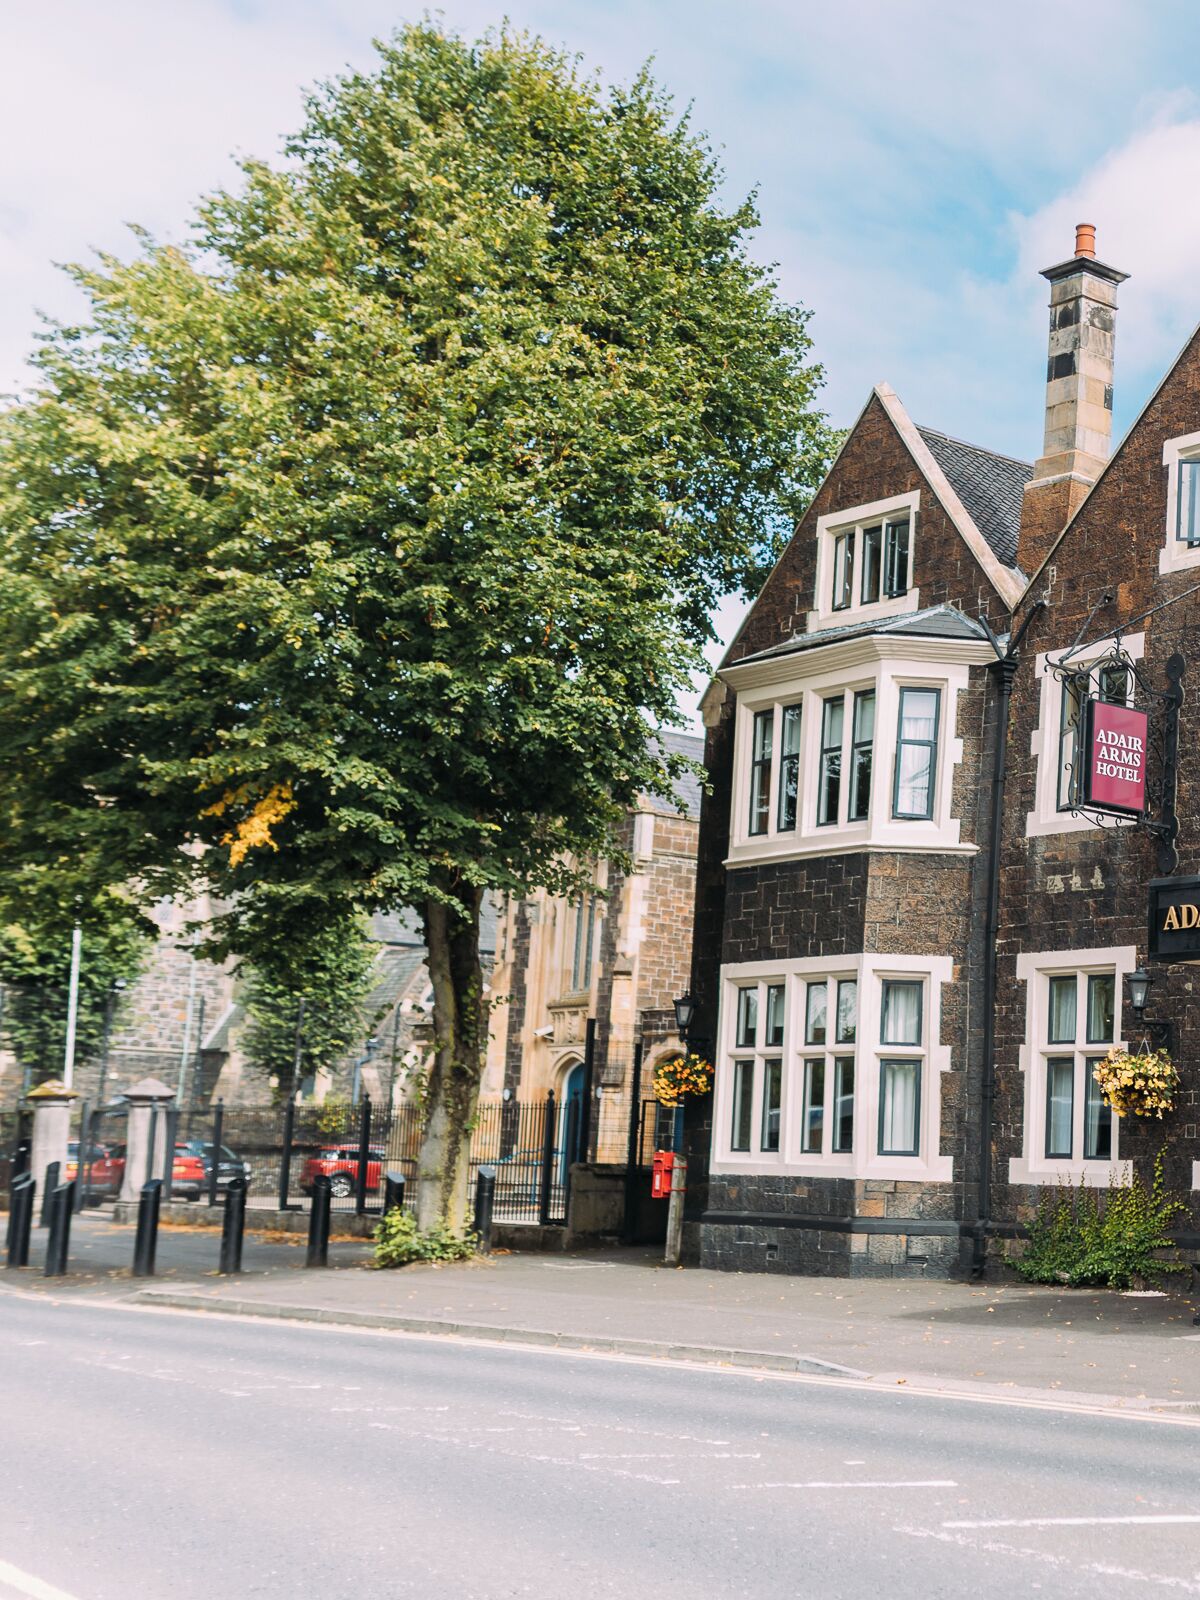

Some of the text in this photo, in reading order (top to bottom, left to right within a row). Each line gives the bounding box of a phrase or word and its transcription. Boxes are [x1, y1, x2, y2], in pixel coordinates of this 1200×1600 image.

[1096, 729, 1144, 753] ADAIR
[1098, 746, 1141, 767] ARMS
[1096, 761, 1141, 783] HOTEL
